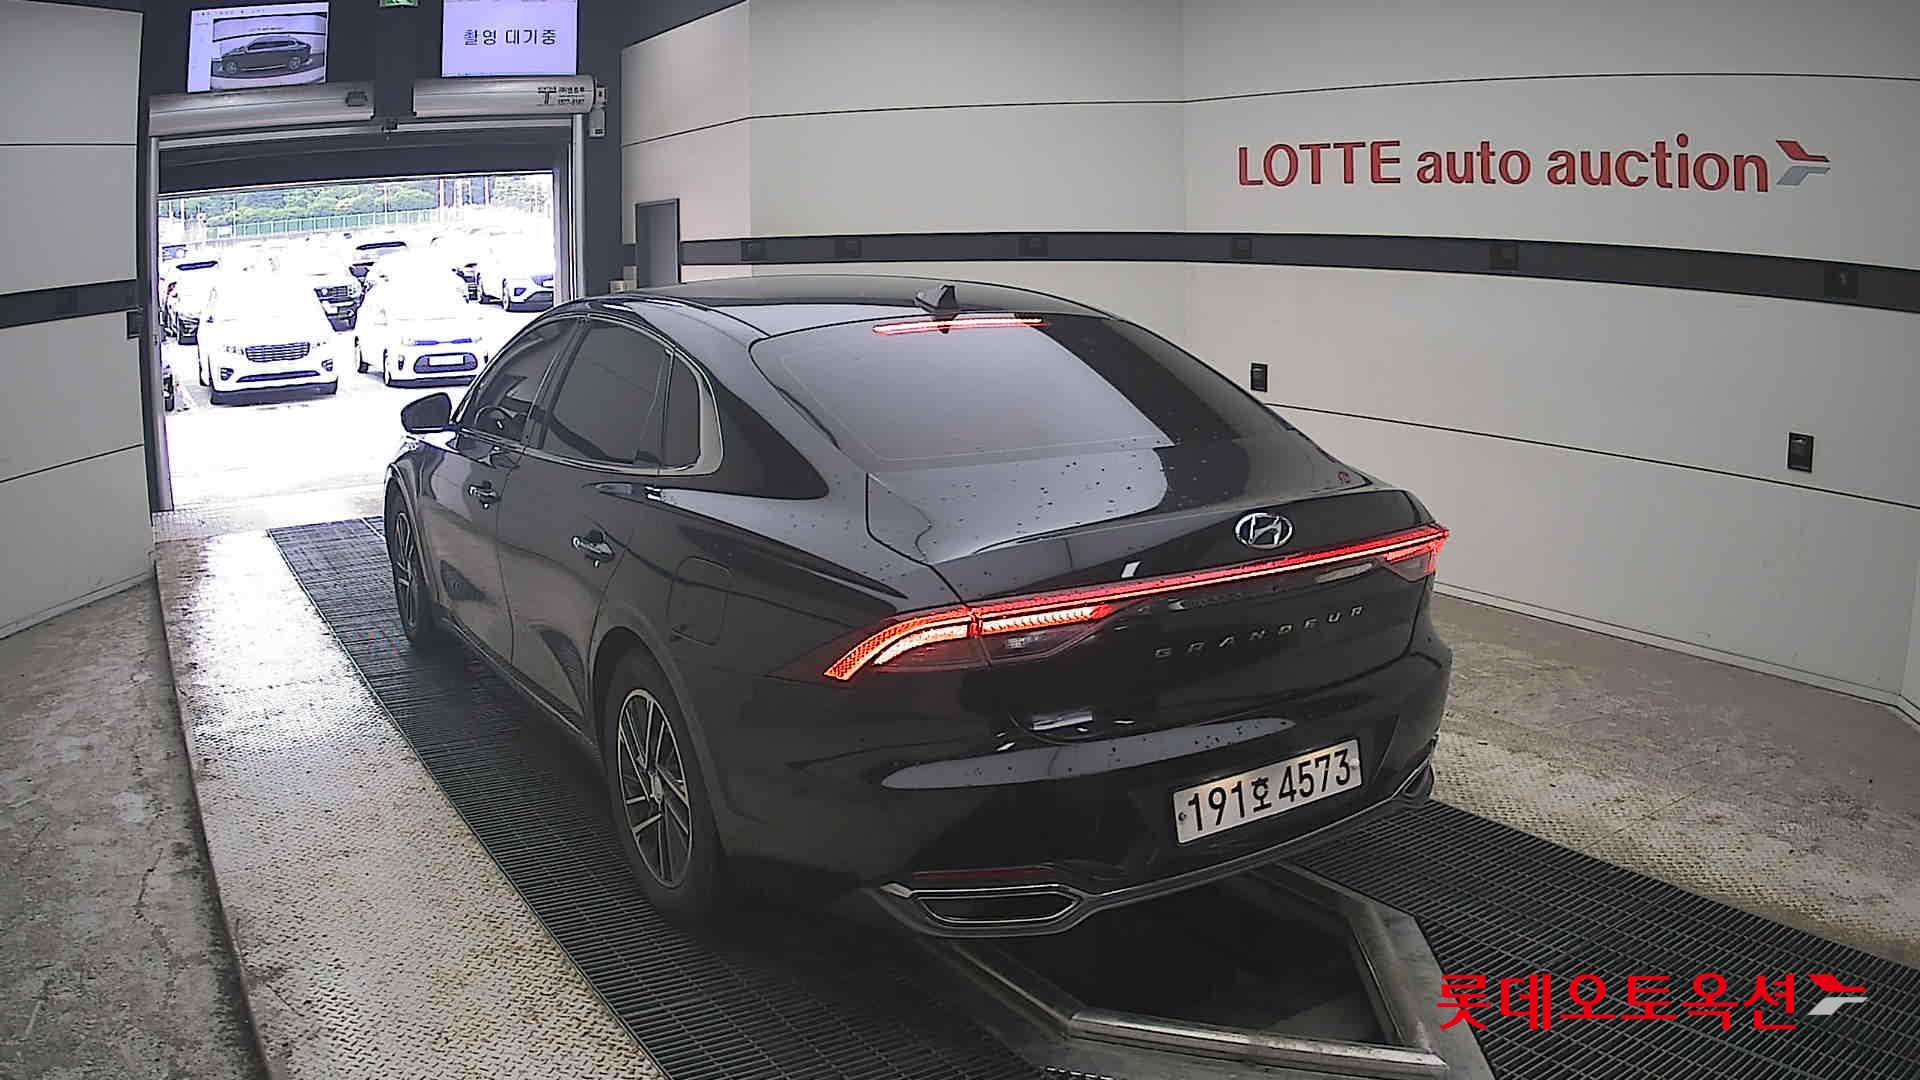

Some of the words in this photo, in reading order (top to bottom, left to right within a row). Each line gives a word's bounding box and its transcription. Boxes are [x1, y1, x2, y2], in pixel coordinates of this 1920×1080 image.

[463, 28, 497, 46] 촬영
[504, 28, 557, 45] 대기중
[1238, 140, 1401, 187] LOTTE
[1416, 140, 1532, 185] auto
[1546, 134, 1769, 193] auction
[1154, 604, 1364, 658] GRANDEUR
[1187, 776, 1272, 832] 191호
[1278, 748, 1351, 803] 4573
